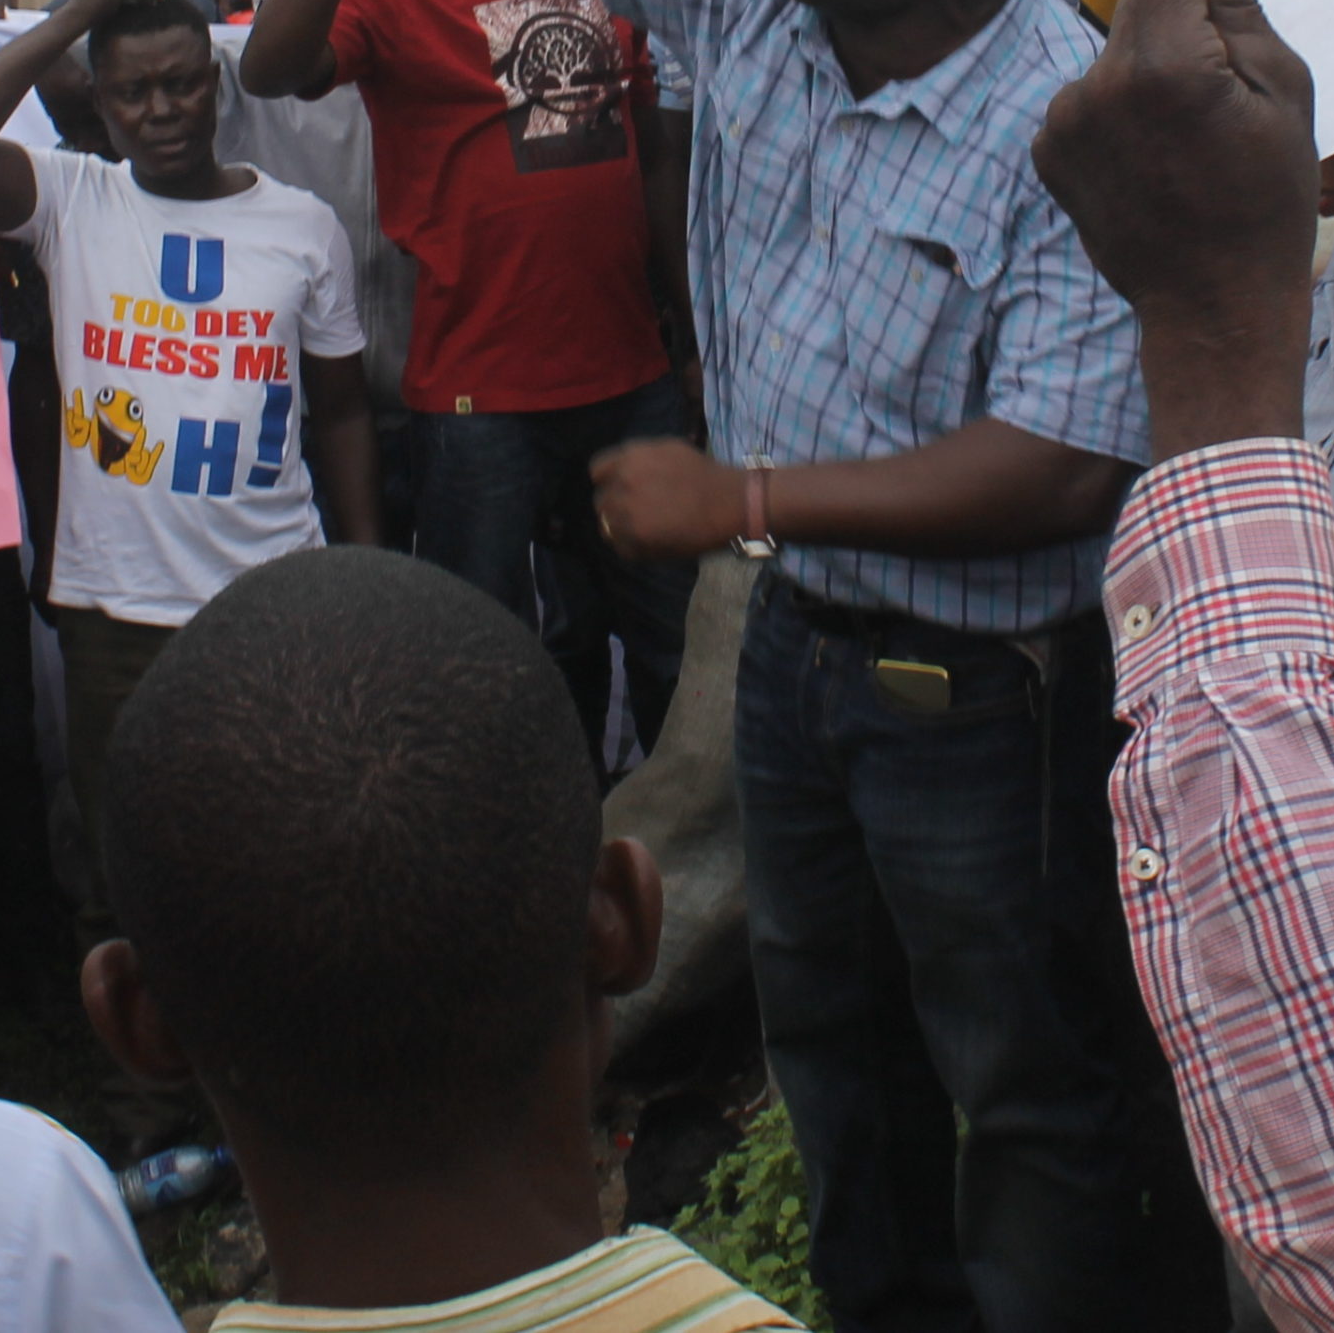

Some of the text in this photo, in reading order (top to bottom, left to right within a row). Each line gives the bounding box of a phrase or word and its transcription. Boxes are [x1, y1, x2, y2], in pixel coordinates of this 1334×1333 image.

[160, 232, 225, 304] U
[109, 293, 276, 338] TOO DEY
[81, 320, 289, 382] BLESS ME
